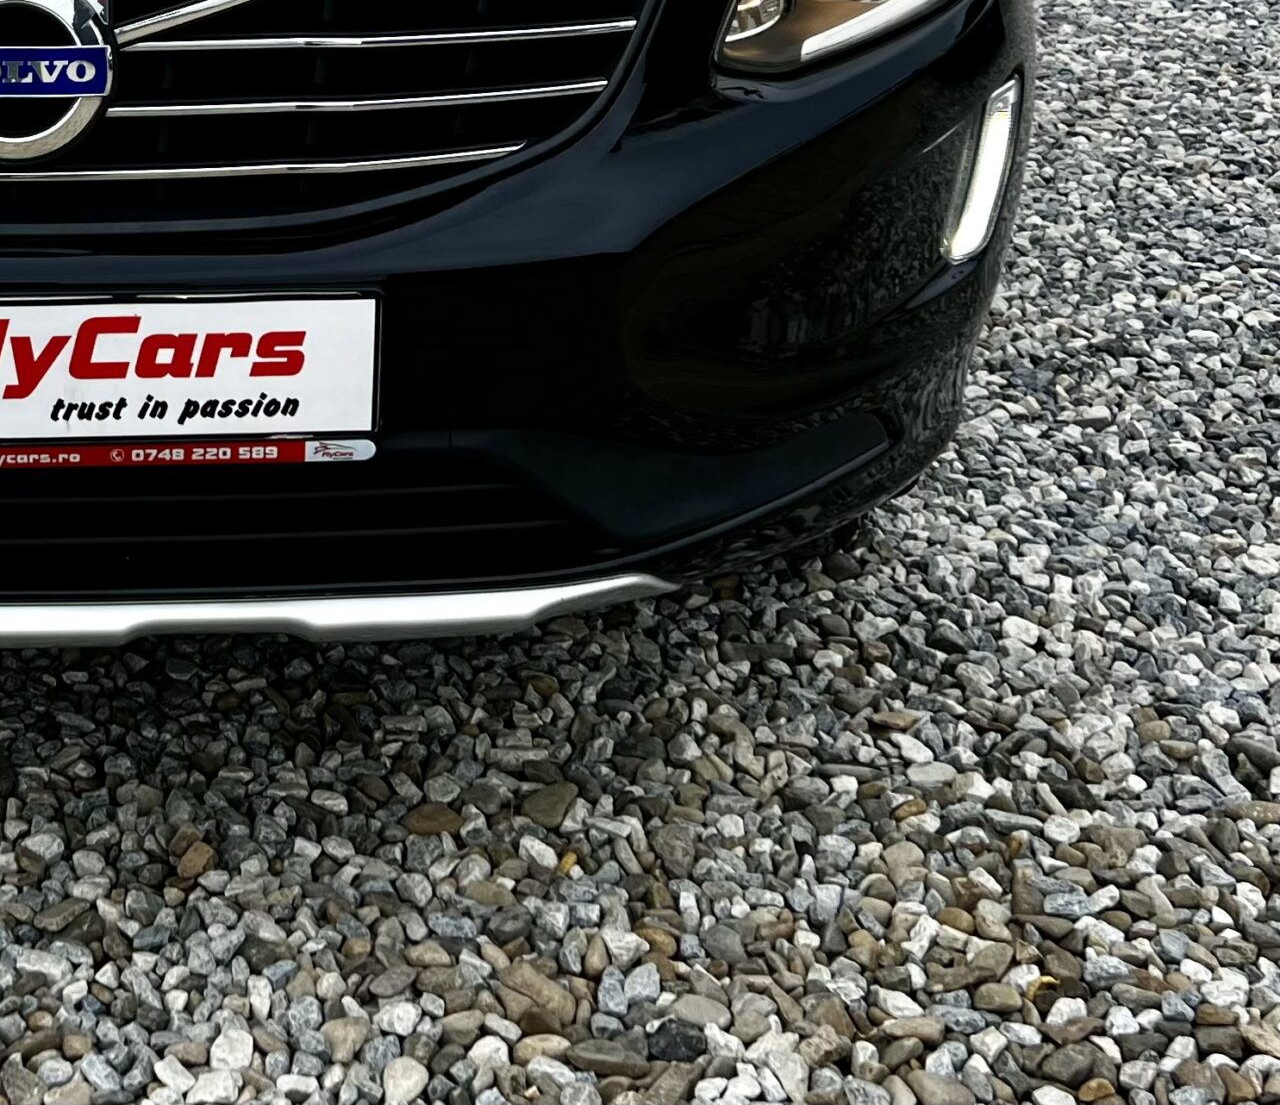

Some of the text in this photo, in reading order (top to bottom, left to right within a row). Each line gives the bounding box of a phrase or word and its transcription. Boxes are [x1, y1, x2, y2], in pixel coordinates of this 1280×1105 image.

[51, 392, 300, 425] trust in passion
[131, 448, 185, 462] 0748
[191, 447, 231, 461] 220
[238, 446, 279, 460] 589
